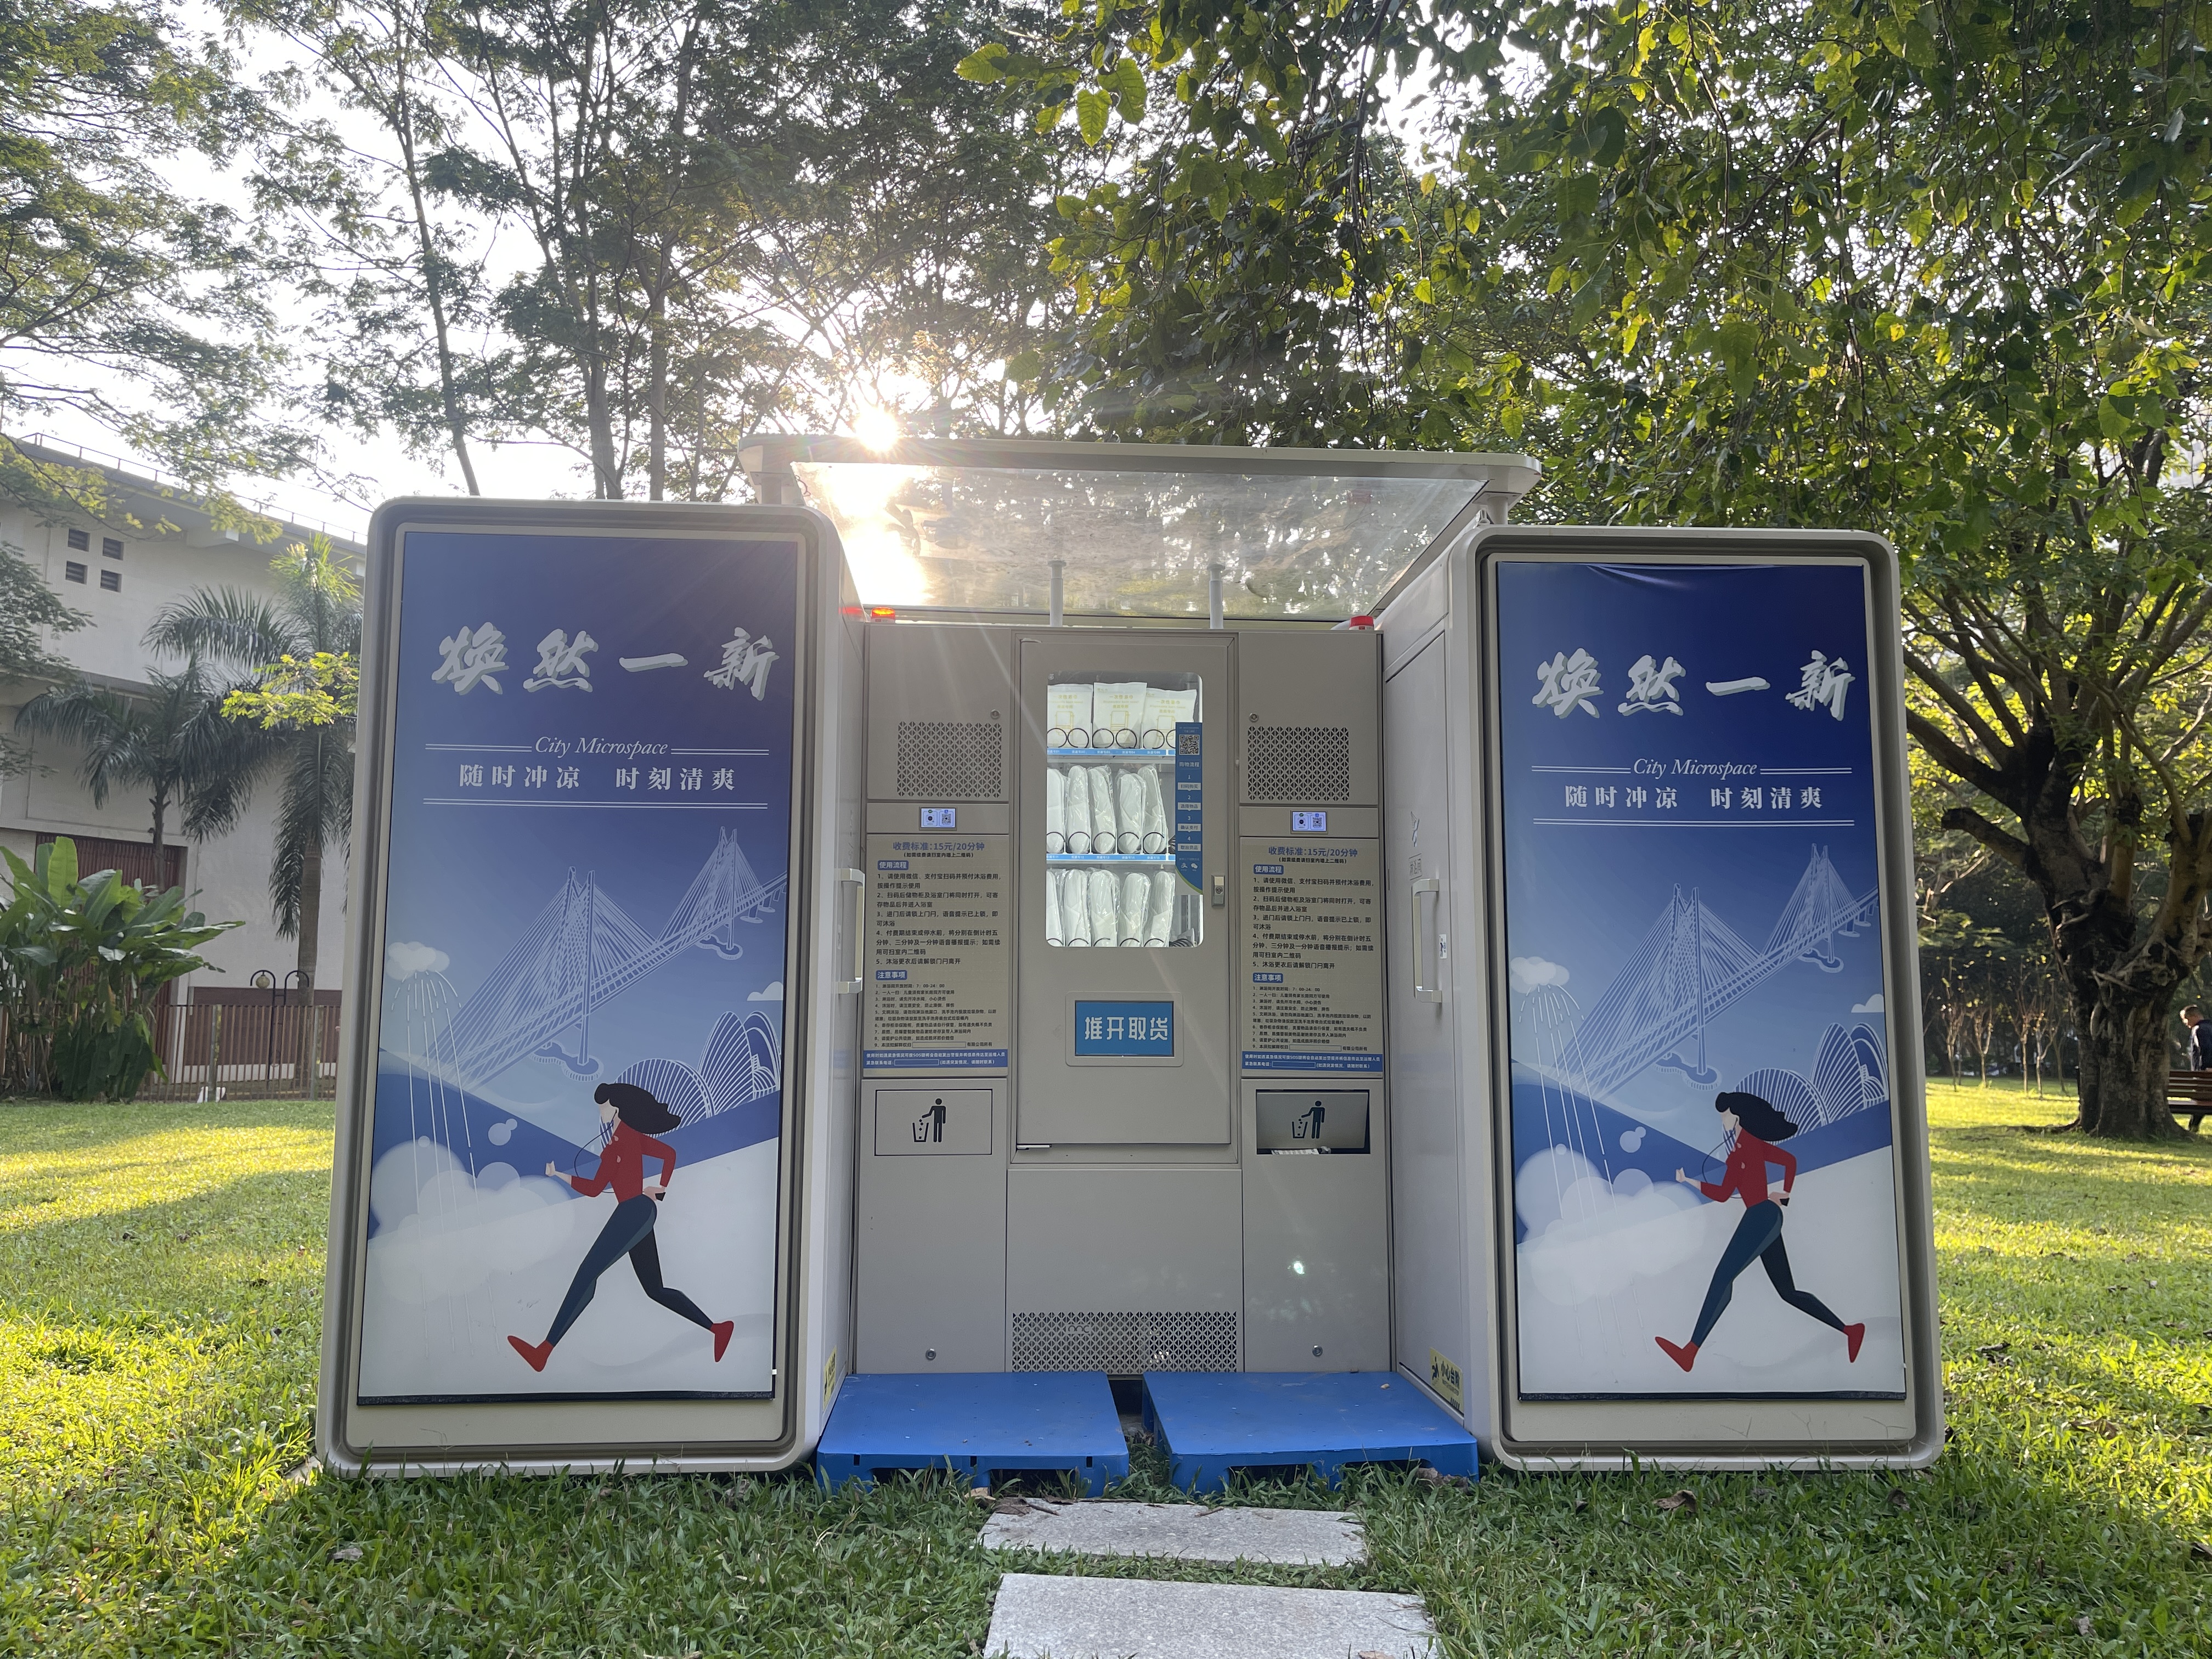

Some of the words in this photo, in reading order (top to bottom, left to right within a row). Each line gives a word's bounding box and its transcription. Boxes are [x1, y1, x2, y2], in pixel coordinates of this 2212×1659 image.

[431, 622, 780, 701] 焕然一新
[1532, 647, 1855, 721] 焕然一新
[535, 736, 571, 758] City
[575, 737, 668, 760] Microspace
[459, 764, 580, 790] 随时冲凉
[615, 768, 735, 791] 时刻清爽
[1633, 758, 1667, 780] City
[1671, 759, 1757, 780] Microspace
[1565, 785, 1678, 809] 随时冲凉
[1711, 787, 1822, 809] 时刻清爽
[893, 842, 985, 851] 收费标准:15元/20分钟
[1269, 847, 1357, 857] 收费标准:15元/20分钟
[1085, 1017, 1169, 1041] 推开取货
